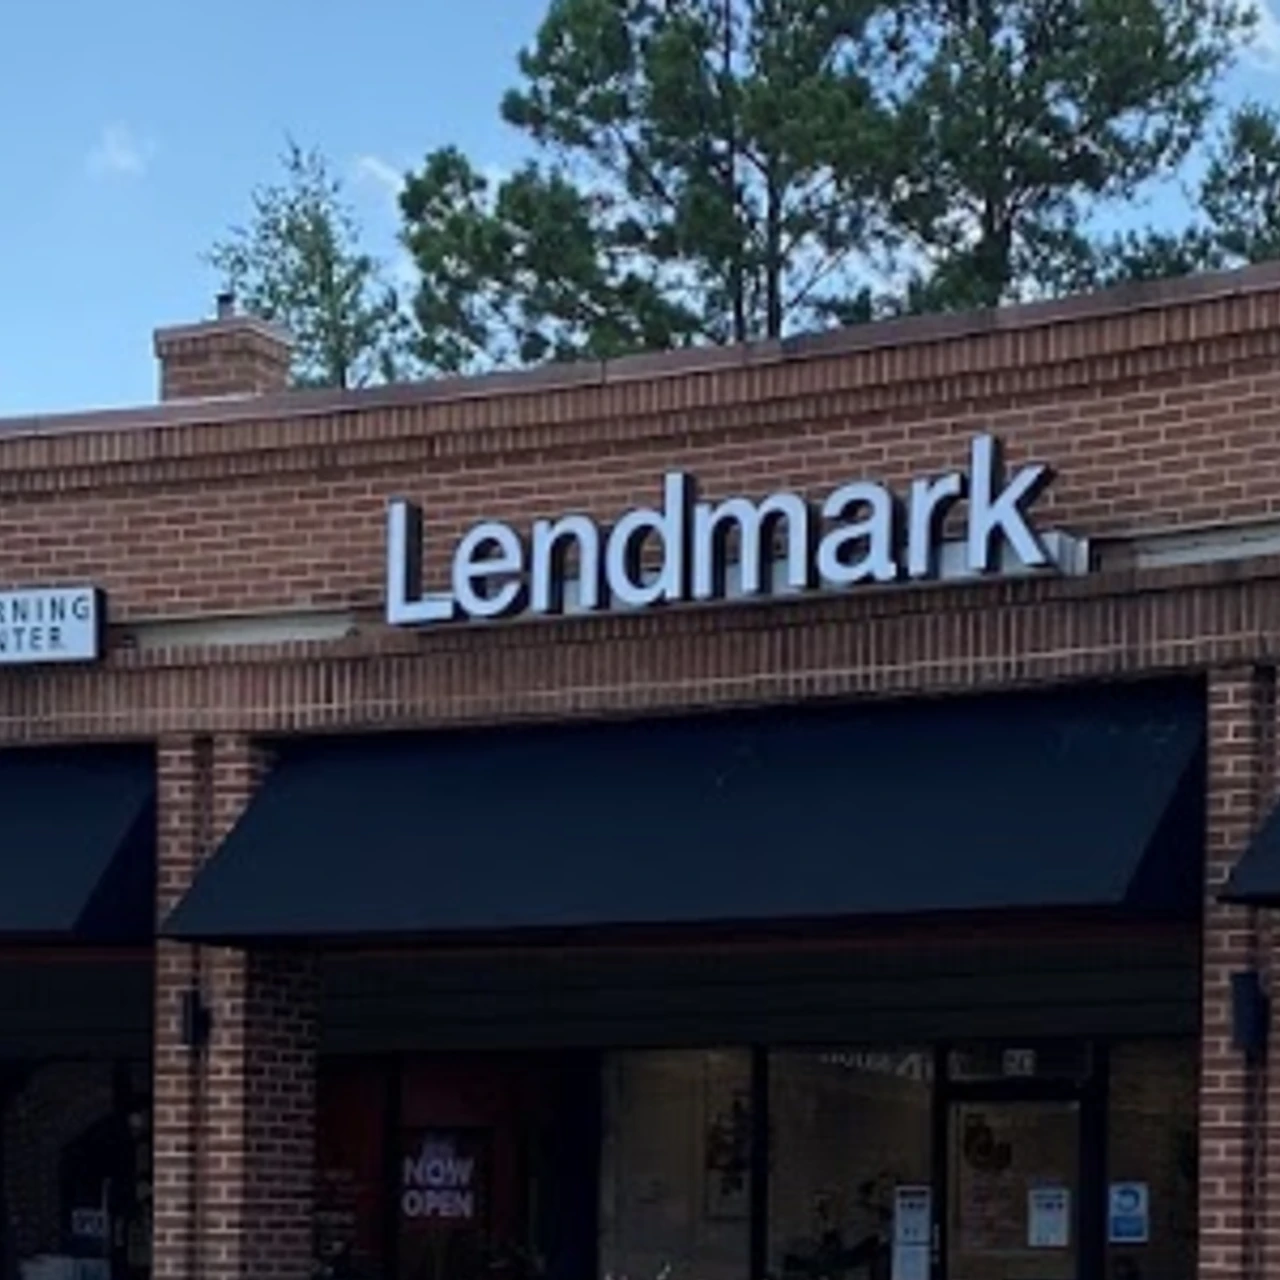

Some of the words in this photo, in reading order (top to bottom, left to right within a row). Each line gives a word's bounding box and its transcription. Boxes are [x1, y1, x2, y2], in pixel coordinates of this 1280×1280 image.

[387, 434, 1054, 624] Lendmark
[402, 1154, 475, 1187] NOW
[400, 1188, 475, 1218] OPEN
